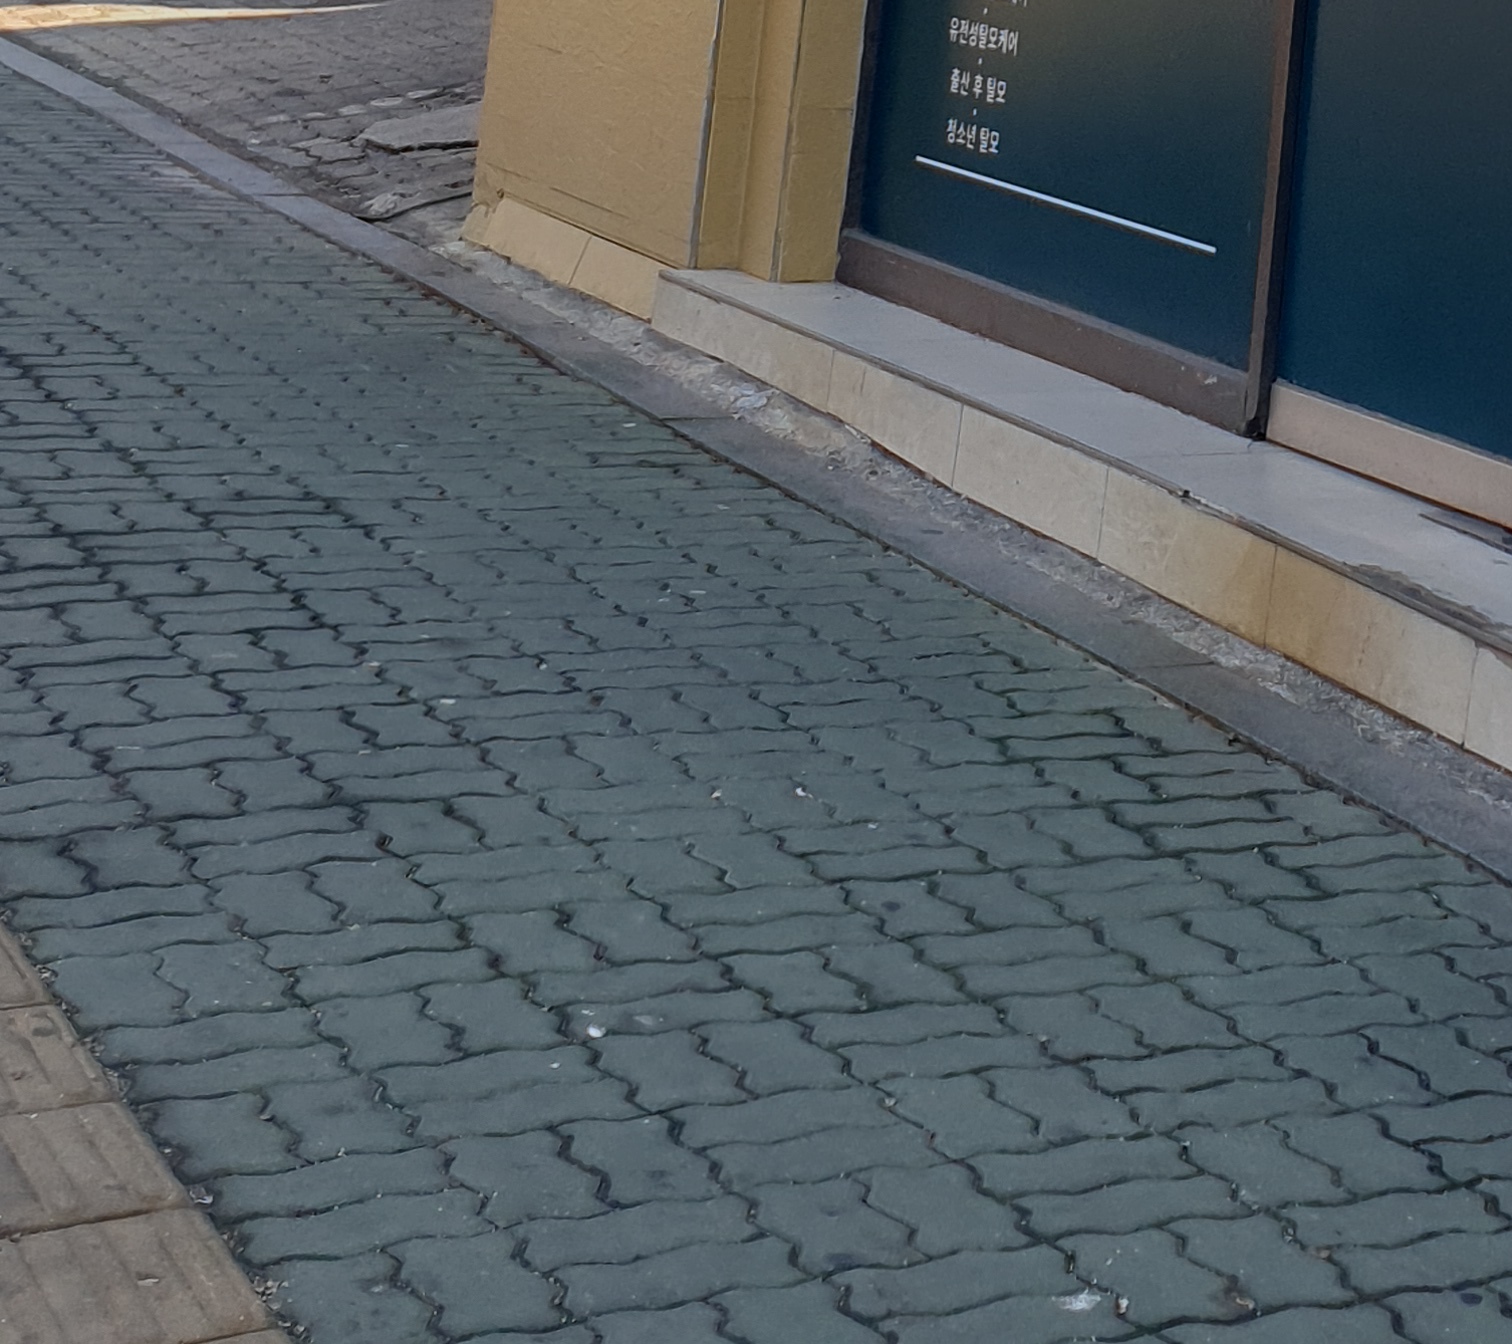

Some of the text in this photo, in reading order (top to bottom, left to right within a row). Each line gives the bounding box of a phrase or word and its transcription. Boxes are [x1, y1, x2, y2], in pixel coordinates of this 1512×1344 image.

[949, 17, 1020, 57] 유전성탈모케어
[950, 67, 1007, 104] 출산 후 탈모
[946, 118, 1000, 154] 청소년 탈모
